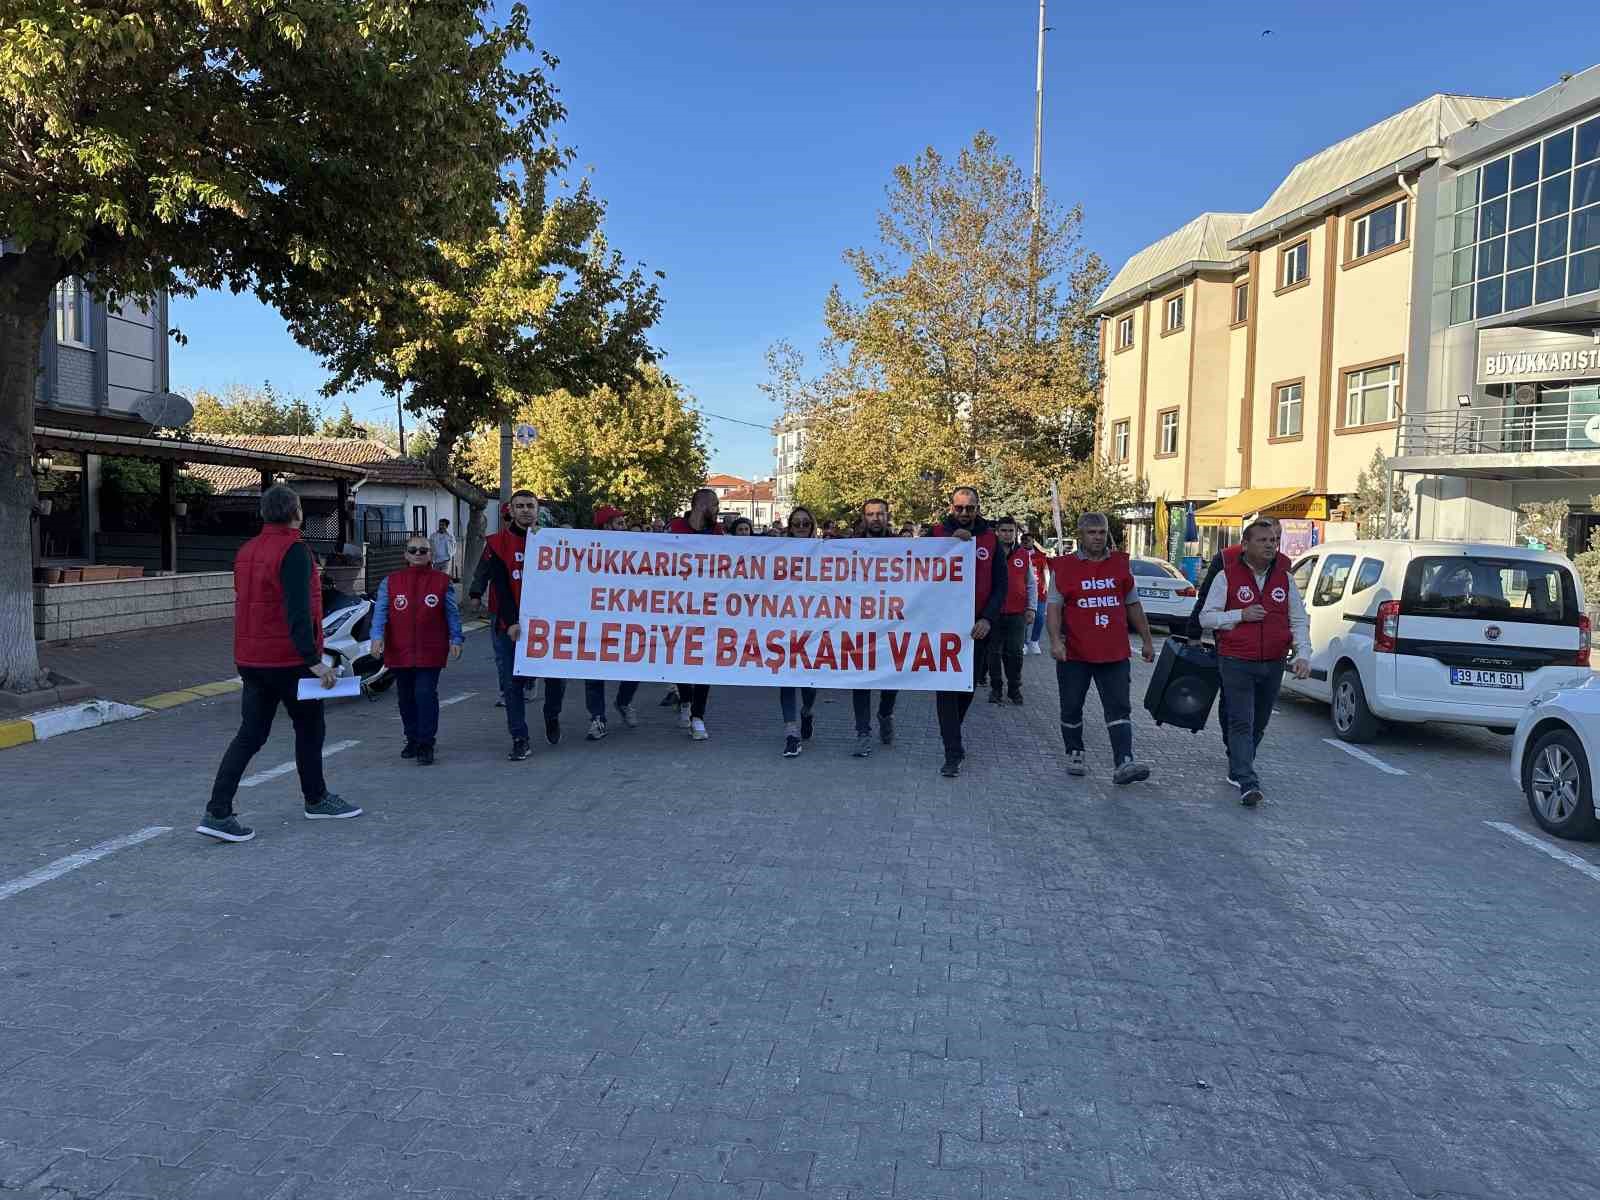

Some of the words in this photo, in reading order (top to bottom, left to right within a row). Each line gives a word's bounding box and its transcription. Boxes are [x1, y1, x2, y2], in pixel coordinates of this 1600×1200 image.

[537, 538, 766, 581] BÜYÜKKARIŞTIRAN
[774, 550, 963, 582] BELEDİYESİNDE
[1081, 577, 1116, 590] DİSK
[590, 587, 719, 615] EKMEKLE
[726, 592, 851, 619] OYNAYAN
[860, 590, 905, 621] BİR
[1077, 595, 1120, 608] GENEL
[715, 626, 877, 674] BAŞKANI
[887, 631, 963, 673] VAR
[1458, 670, 1472, 682] 39
[1476, 671, 1496, 684] ACM
[1499, 673, 1519, 685] 601
